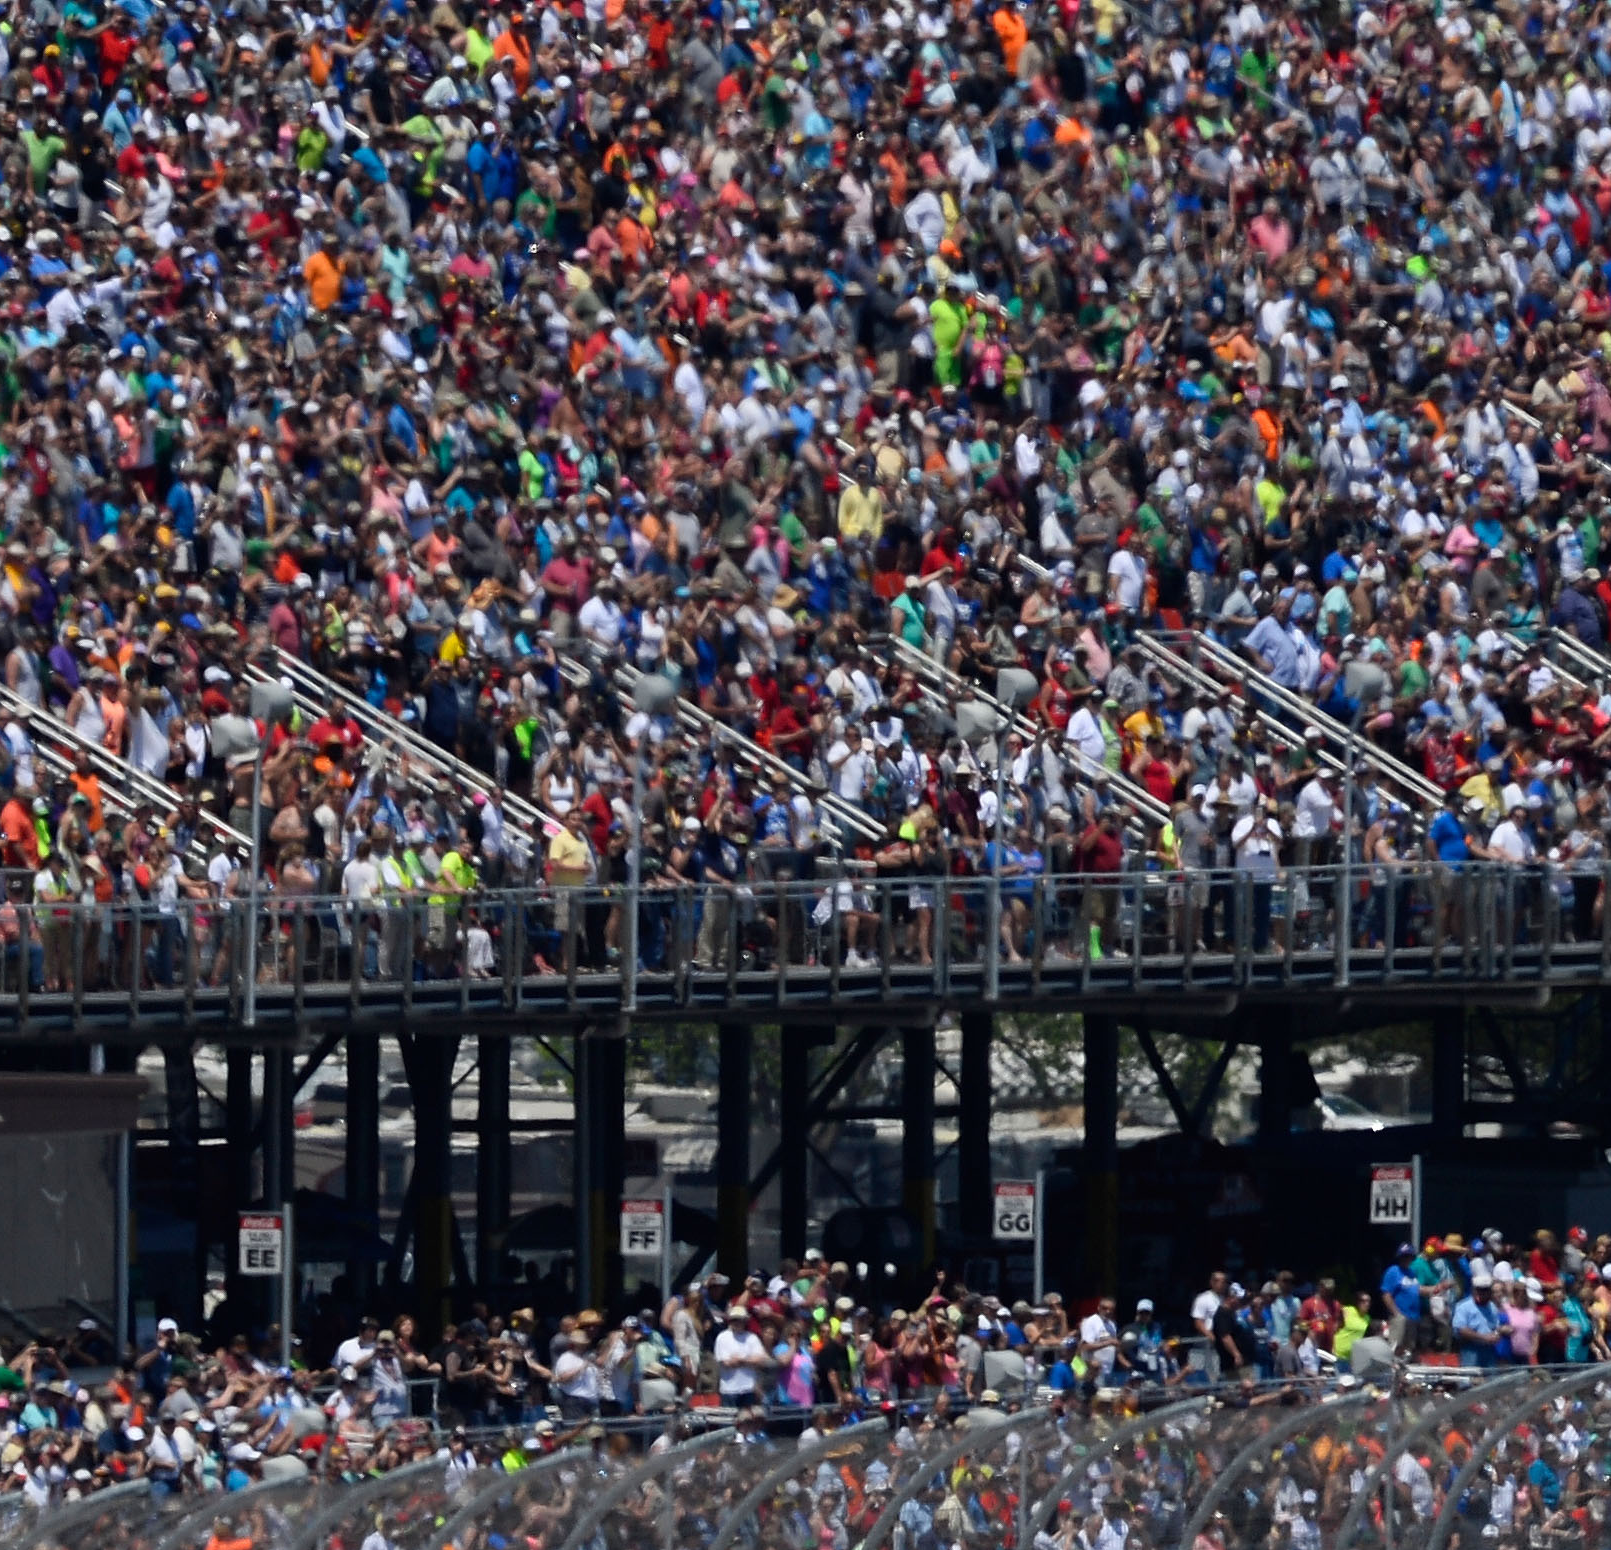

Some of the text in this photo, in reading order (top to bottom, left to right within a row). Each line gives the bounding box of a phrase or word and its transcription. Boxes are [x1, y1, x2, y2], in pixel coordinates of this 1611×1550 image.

[1376, 1198, 1407, 1217] HH
[999, 1213, 1030, 1232] GG
[629, 1231, 655, 1249] FF
[247, 1249, 276, 1268] EE
